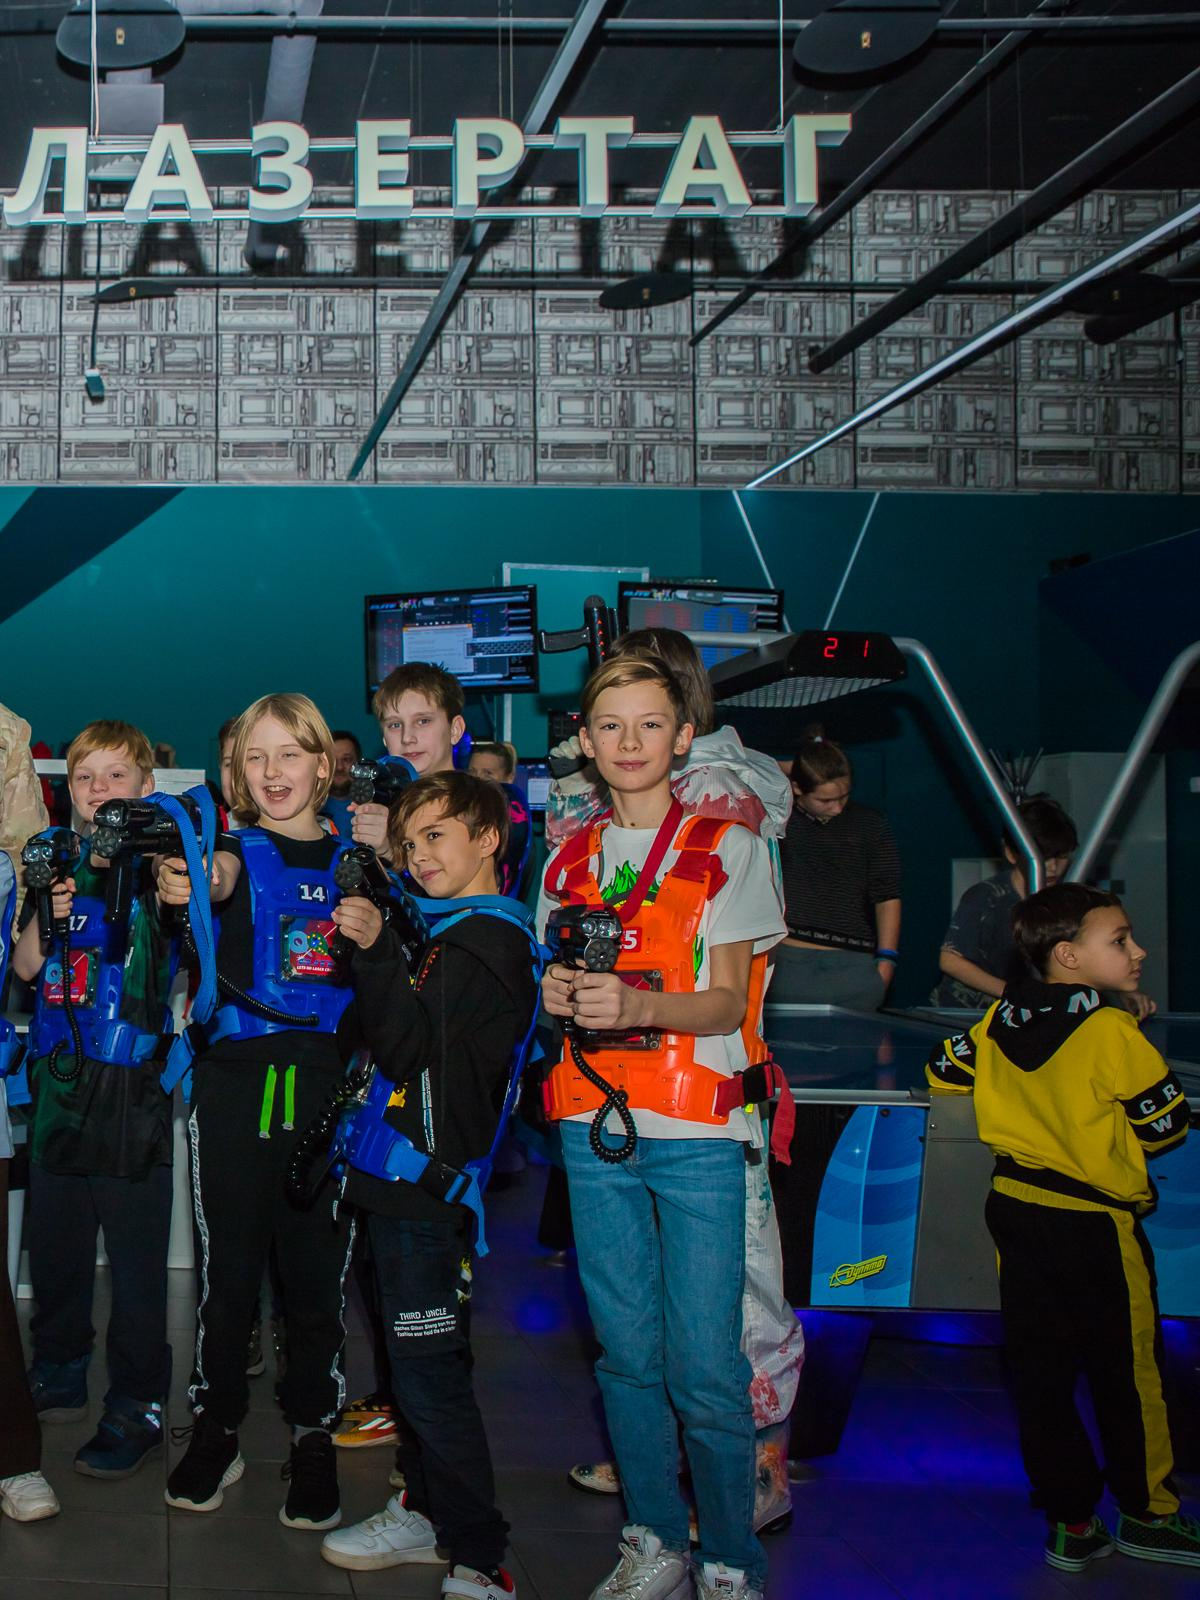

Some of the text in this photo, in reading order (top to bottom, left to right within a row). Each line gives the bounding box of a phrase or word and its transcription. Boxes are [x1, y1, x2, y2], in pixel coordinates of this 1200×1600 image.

[3, 113, 851, 224] ЛАЗЕРТАГ
[823, 637, 870, 658] 2 1
[300, 884, 326, 902] 14
[69, 914, 88, 931] 17
[399, 1307, 447, 1320] THIRD UNCLE
